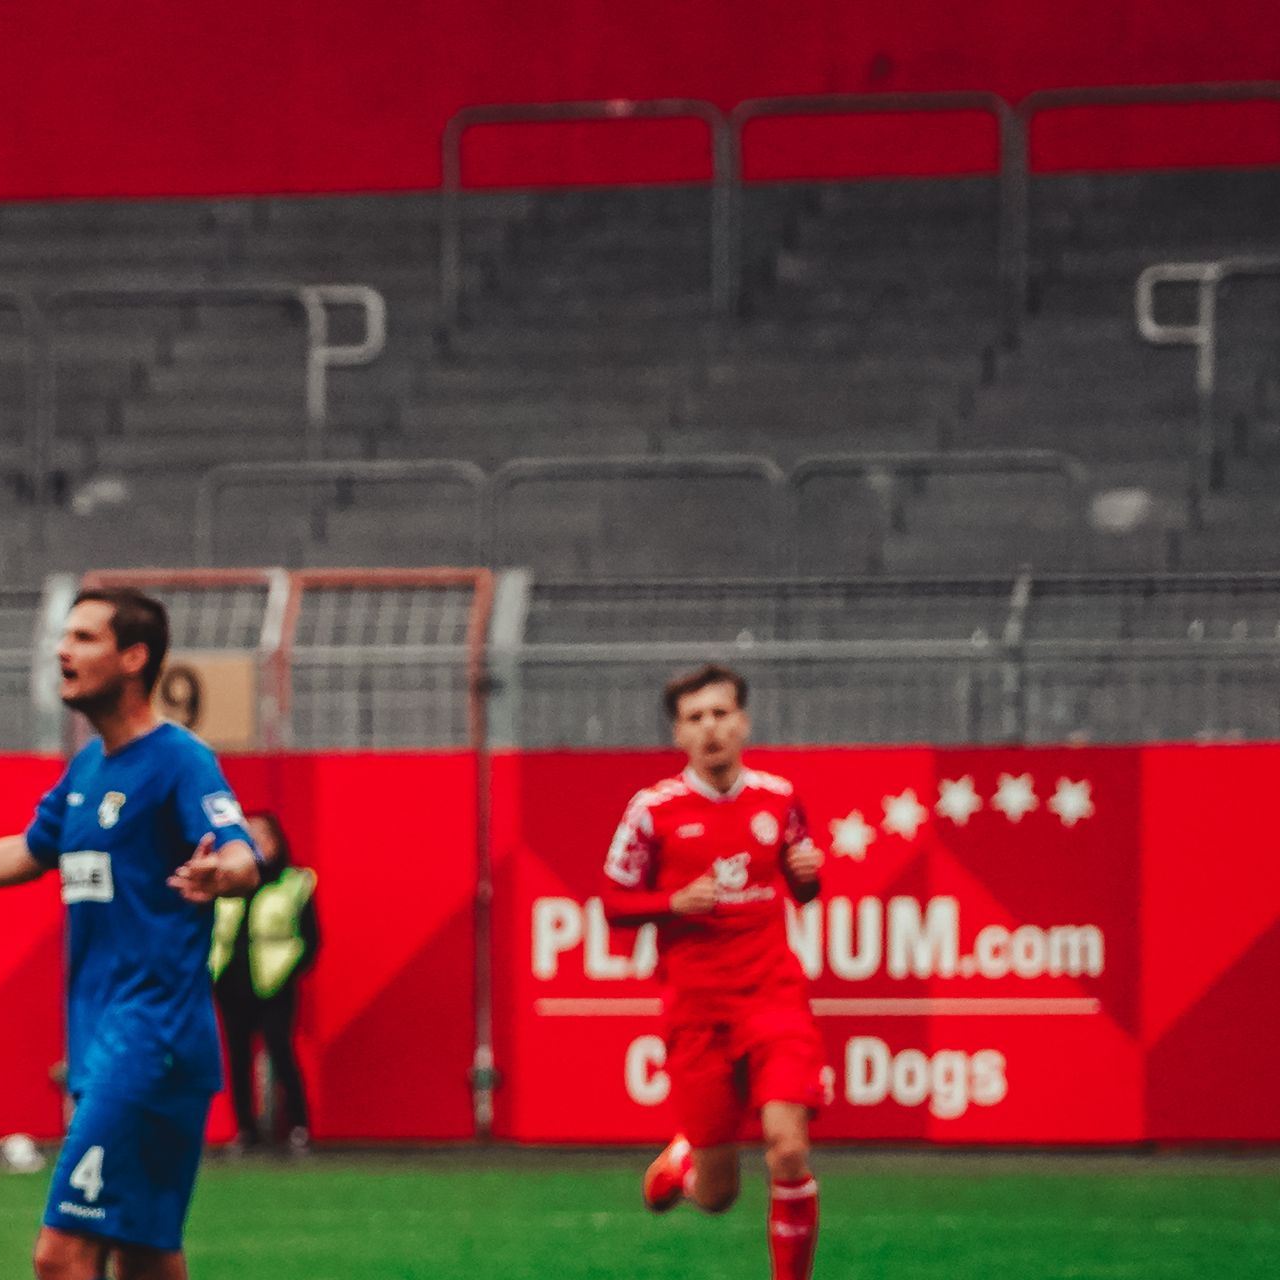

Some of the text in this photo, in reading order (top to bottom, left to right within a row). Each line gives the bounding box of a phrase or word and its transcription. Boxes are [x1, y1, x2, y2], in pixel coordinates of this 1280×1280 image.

[531, 895, 1104, 980] PLNUM.com
[845, 1035, 1007, 1119] Dogs
[69, 1145, 105, 1202] 4
